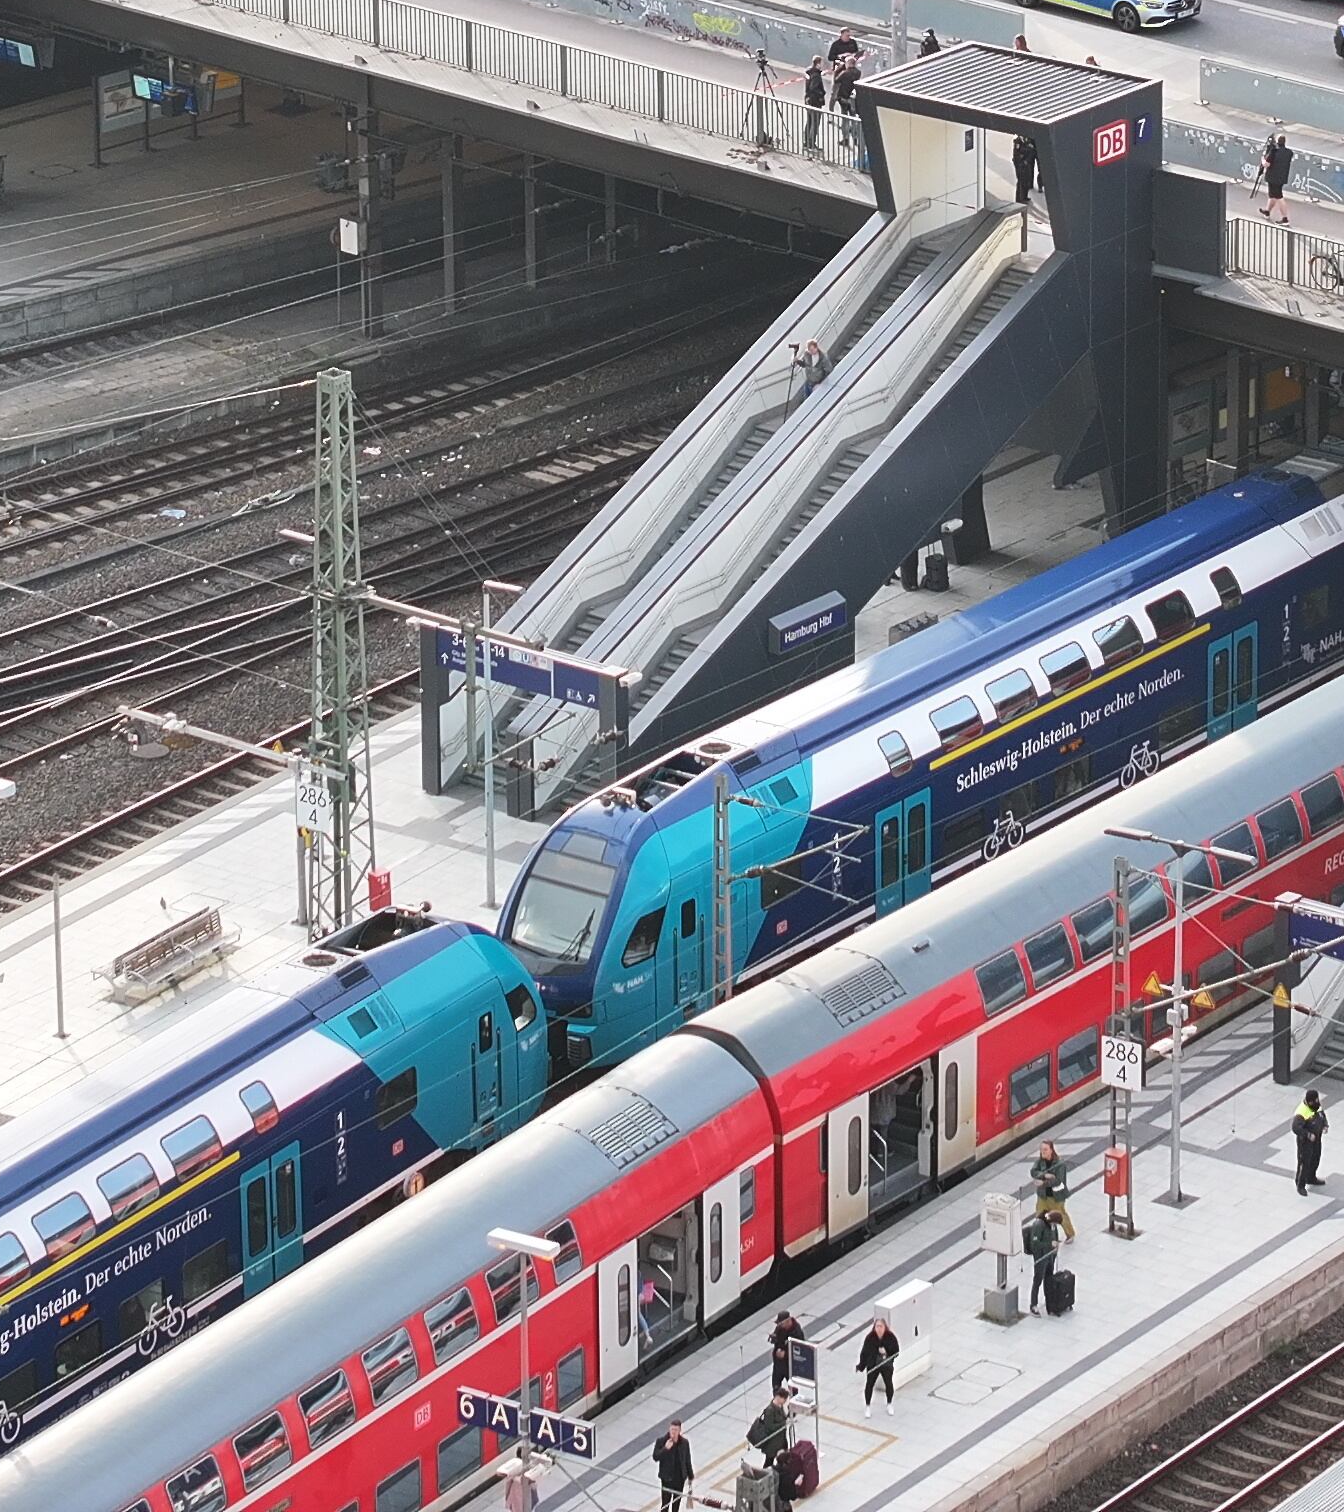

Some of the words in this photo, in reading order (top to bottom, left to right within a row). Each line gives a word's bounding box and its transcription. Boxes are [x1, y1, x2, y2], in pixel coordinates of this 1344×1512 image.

[1100, 128, 1124, 160] DB
[1137, 117, 1147, 138] 7
[1284, 603, 1289, 619] 1
[785, 622, 818, 644] Hamburg
[819, 612, 832, 629] Hbf
[1283, 626, 1290, 642] 2
[956, 722, 1077, 793] Schleswig-Holstein.
[1080, 707, 1101, 730] Der
[1103, 690, 1134, 717] echte
[1138, 667, 1184, 701] Norden.
[299, 785, 326, 808] 286
[309, 809, 317, 825] 4
[834, 856, 841, 874] 2
[1105, 1040, 1138, 1065] 286
[1116, 1065, 1128, 1083] 4
[995, 1082, 1003, 1100] 2
[337, 1112, 343, 1129] 1
[337, 1138, 345, 1156] 2
[85, 1265, 110, 1295] Der
[114, 1240, 151, 1276] echte
[155, 1206, 212, 1253] Norden.
[460, 1392, 475, 1420] 6
[490, 1402, 510, 1430] A
[536, 1415, 556, 1443] A
[571, 1424, 588, 1452] 5
